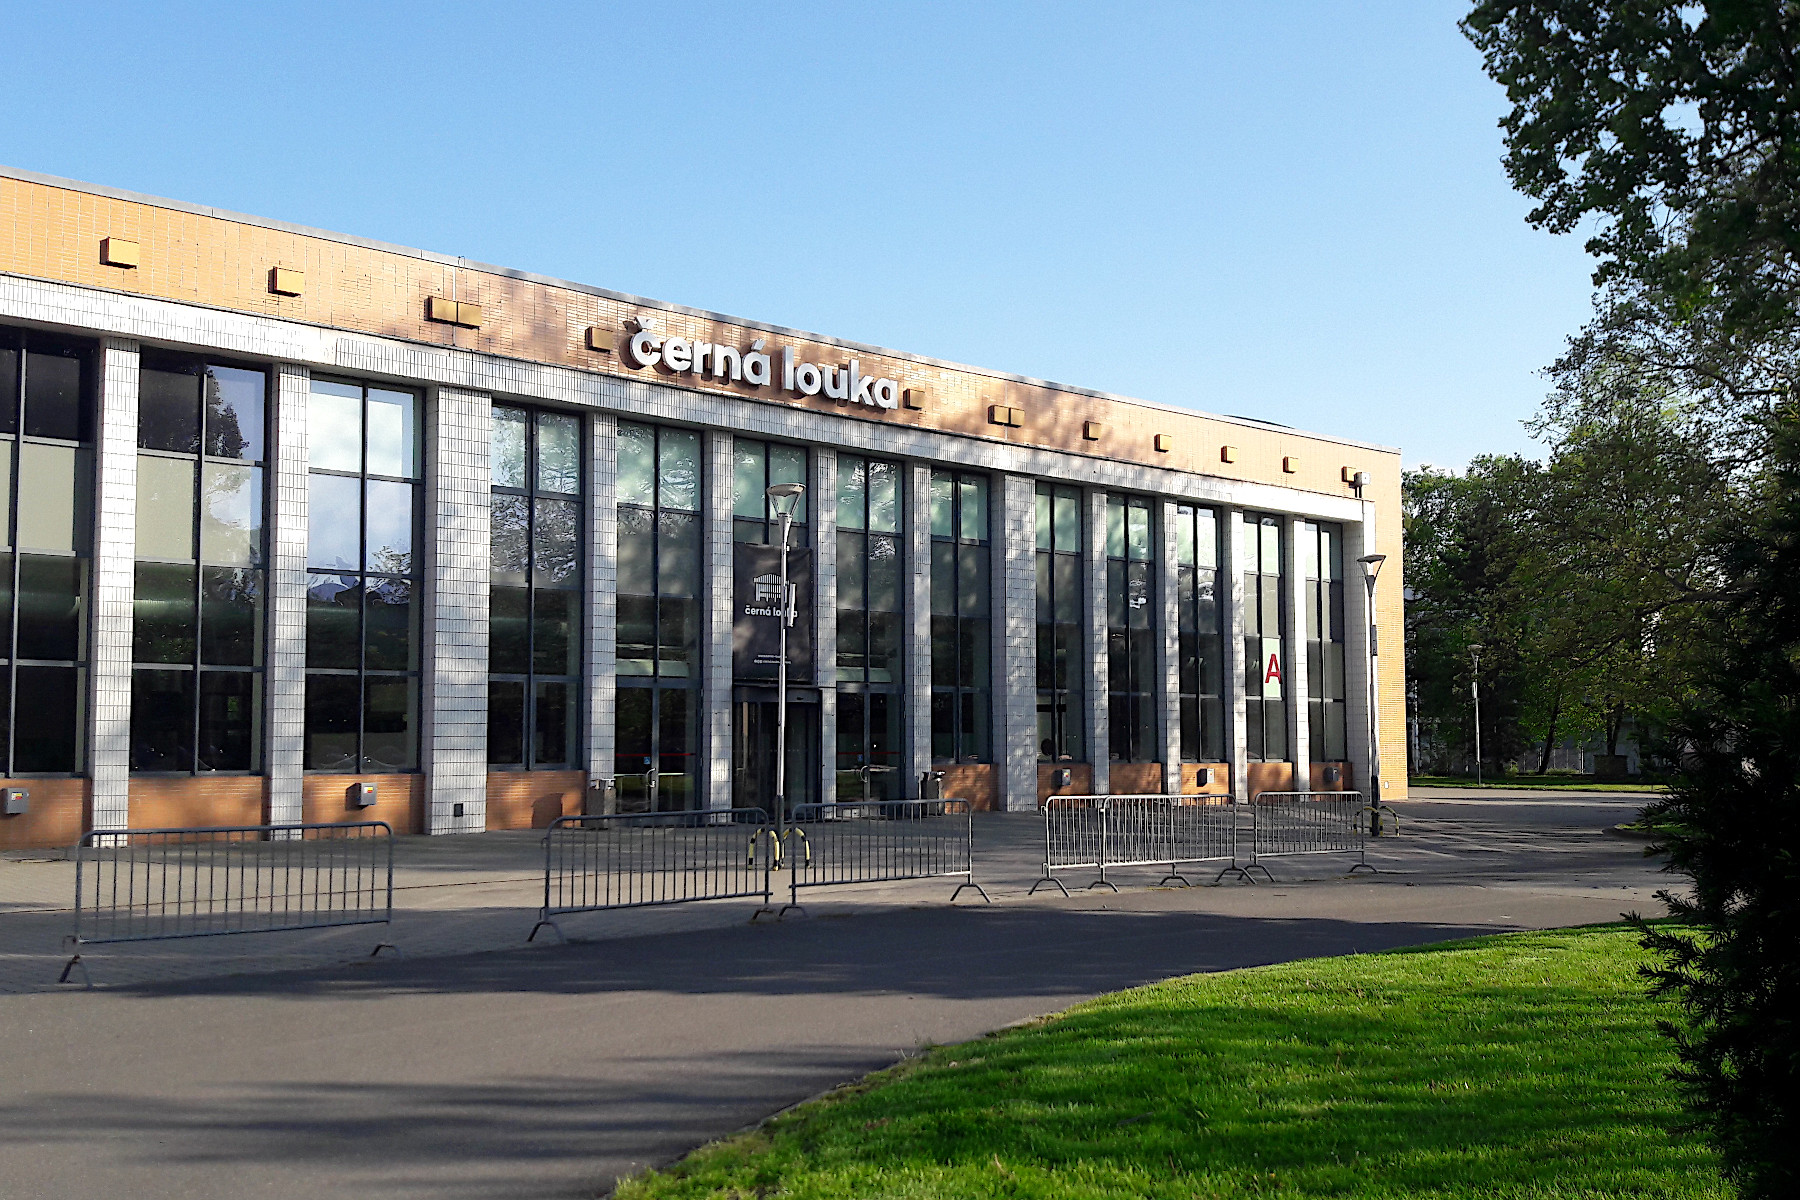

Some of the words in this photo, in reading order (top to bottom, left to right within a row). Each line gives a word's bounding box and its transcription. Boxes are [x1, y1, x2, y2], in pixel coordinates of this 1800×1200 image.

[630, 316, 771, 387] černá
[782, 345, 899, 410] louka
[745, 605, 771, 616] černá
[773, 606, 798, 618] loa
[1264, 653, 1283, 684] A
